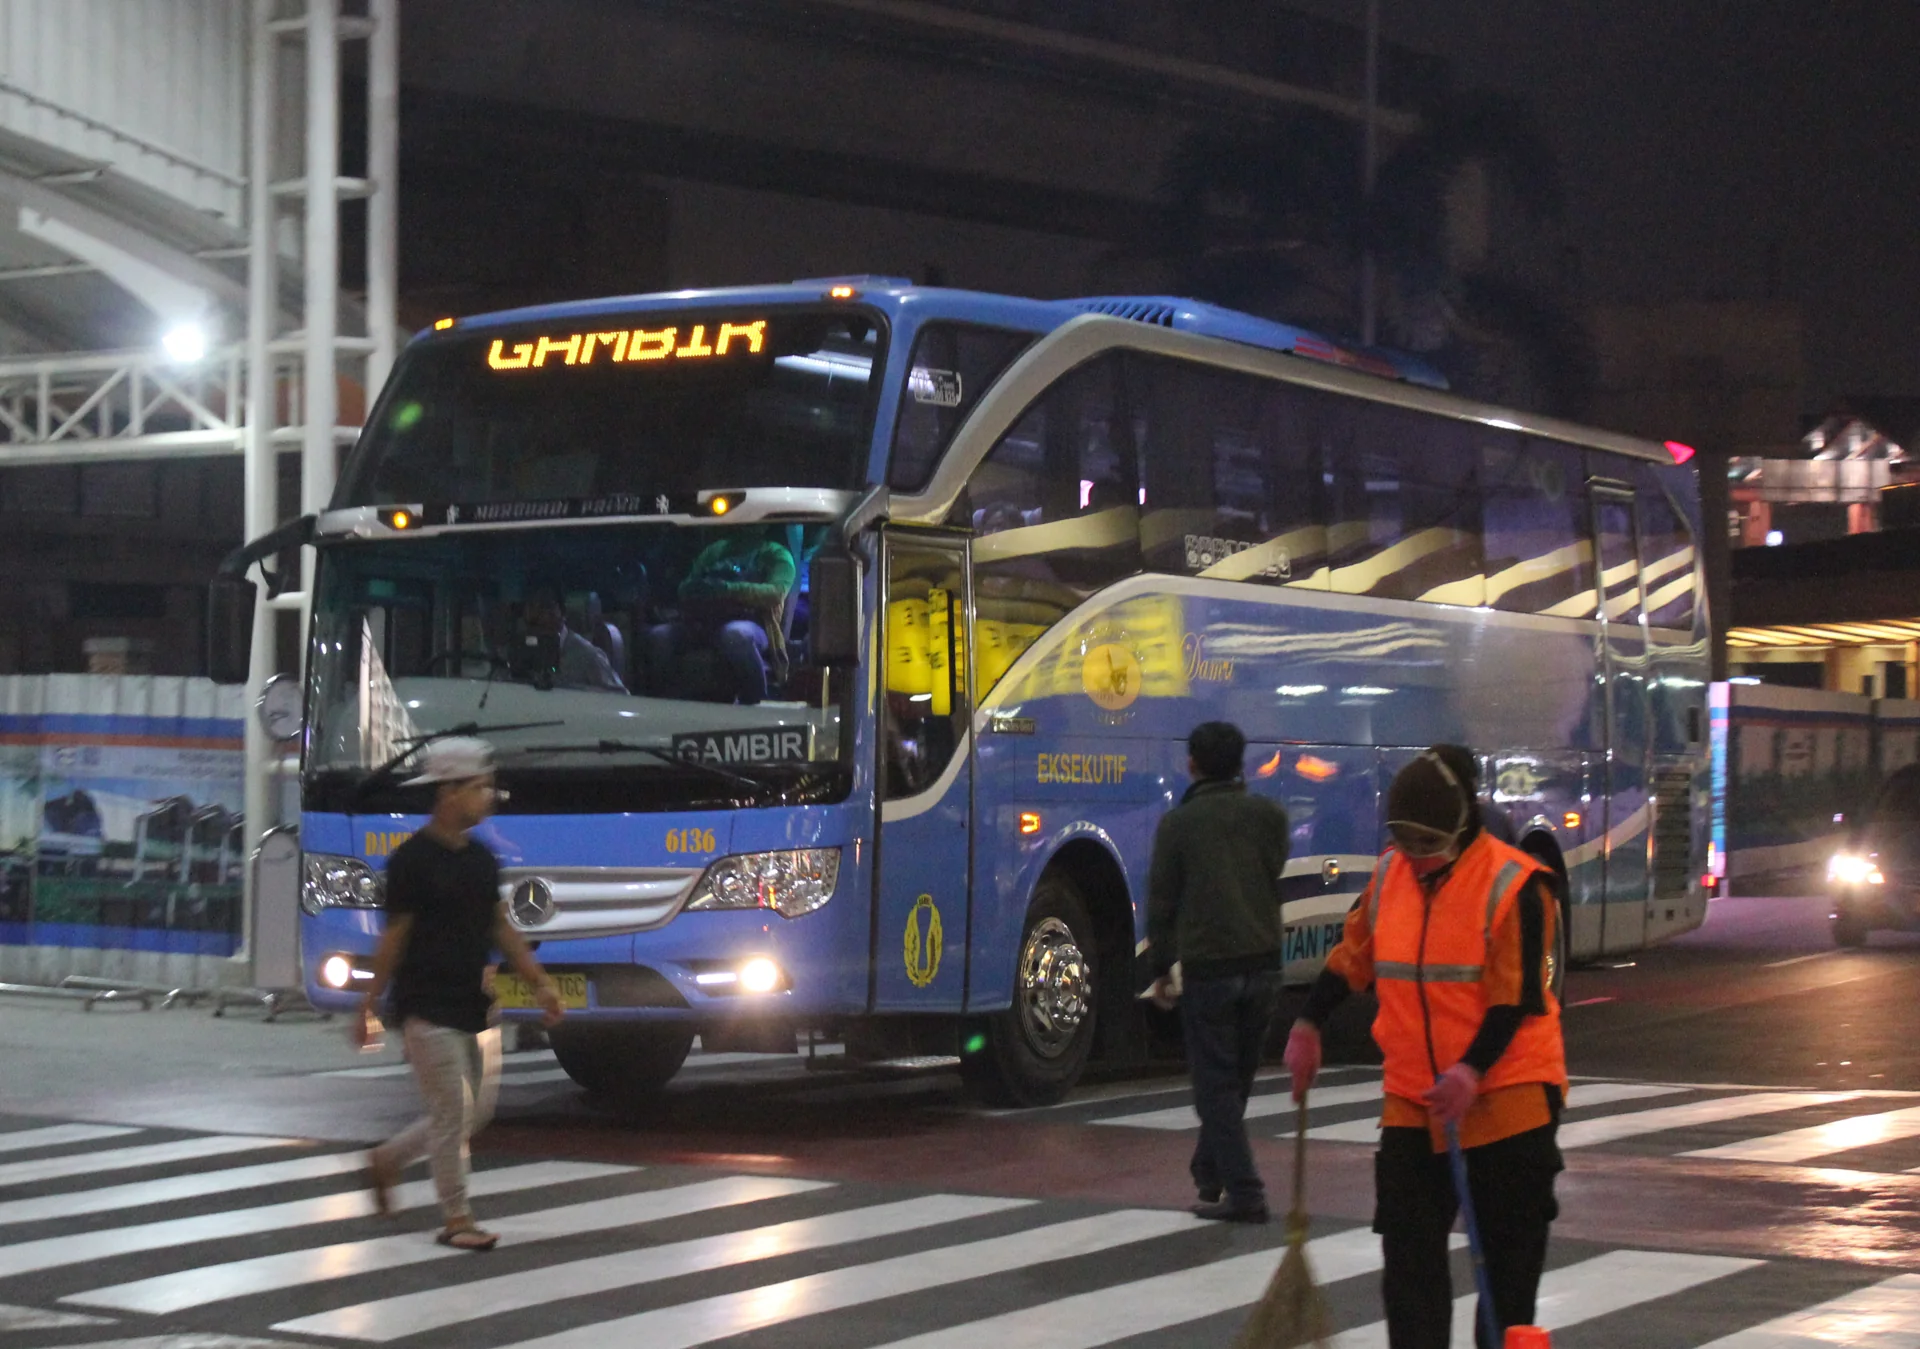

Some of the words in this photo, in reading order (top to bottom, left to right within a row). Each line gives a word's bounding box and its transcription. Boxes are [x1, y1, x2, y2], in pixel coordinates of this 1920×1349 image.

[677, 732, 803, 764] GAMBIR
[1038, 753, 1127, 784] EKSEKUTIF
[665, 827, 716, 853] 6136
